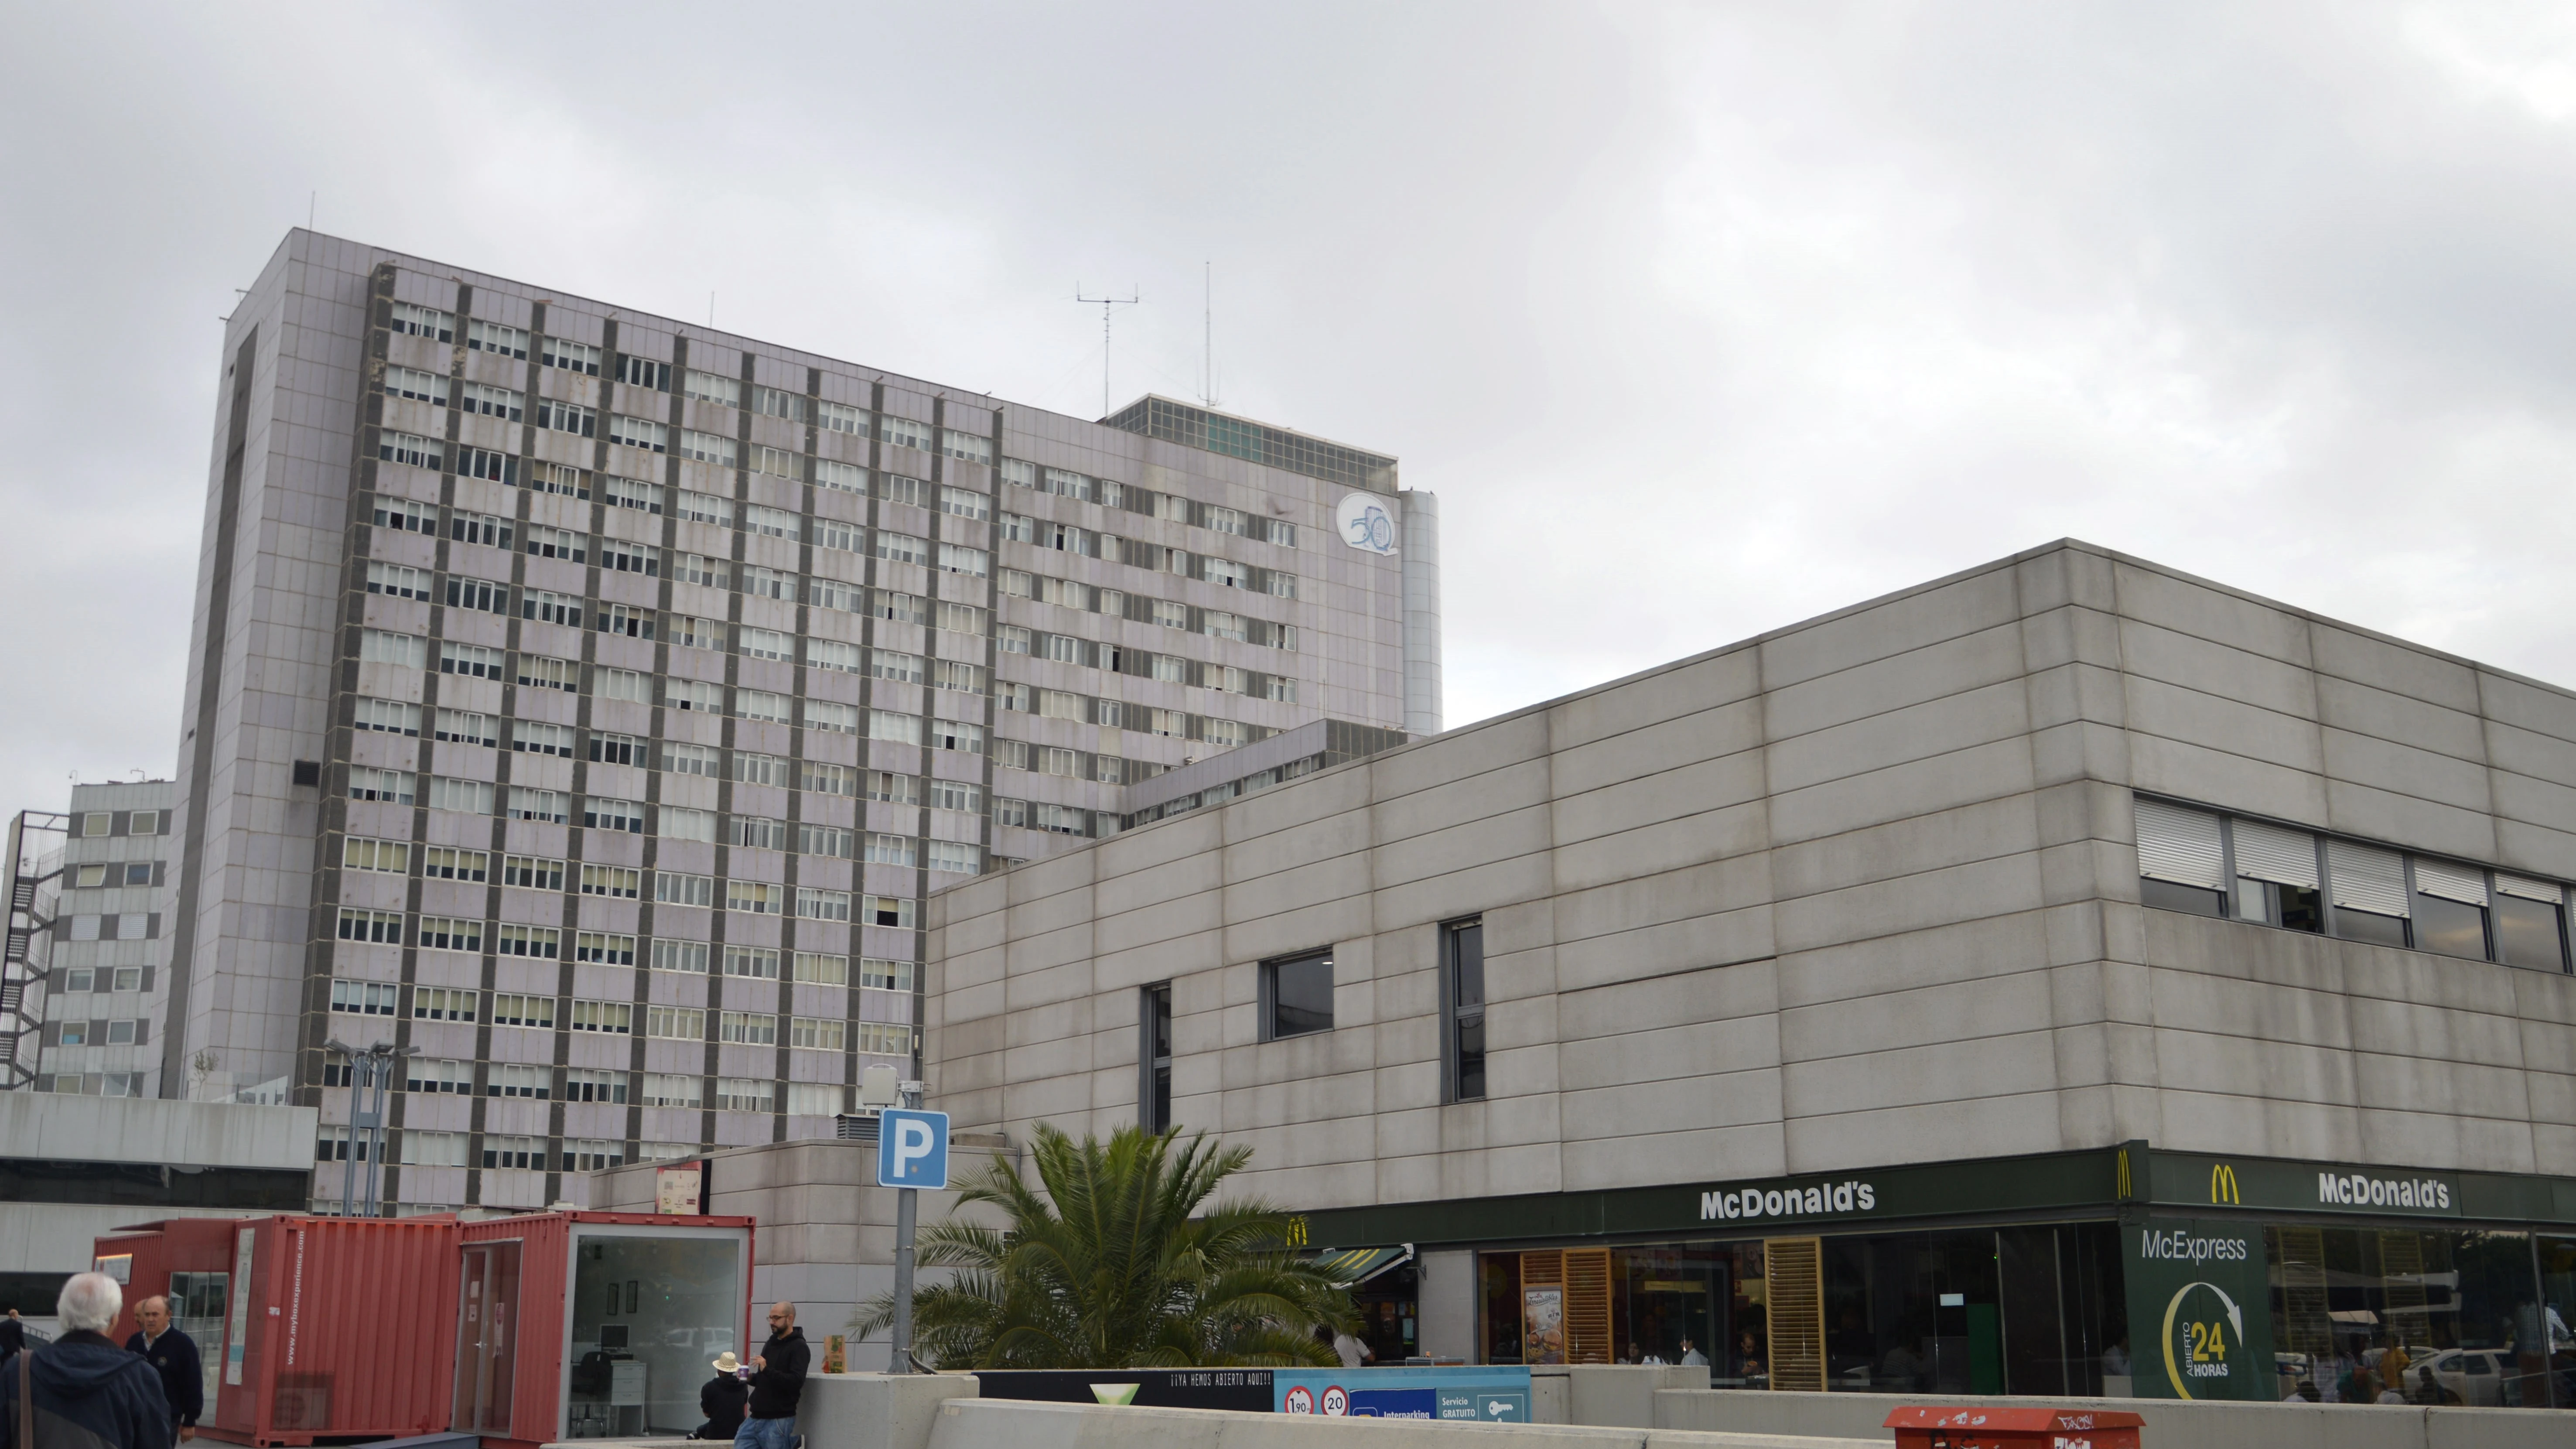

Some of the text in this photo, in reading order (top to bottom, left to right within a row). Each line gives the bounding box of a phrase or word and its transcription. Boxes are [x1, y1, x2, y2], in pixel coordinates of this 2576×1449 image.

[893, 1118, 934, 1178] P
[1701, 1181, 1875, 1220] McDonald's
[2319, 1173, 2450, 1209] McDonald's
[2142, 1230, 2246, 1266] McExpress
[288, 1231, 304, 1364] www.myboxexperience.com
[2183, 1322, 2194, 1377] ABIERTO
[2191, 1322, 2225, 1361] 24
[1191, 1374, 1211, 1386] HEMOS
[1216, 1373, 1243, 1386] ABIERTO
[2194, 1364, 2228, 1377] HORAS
[1328, 1397, 1343, 1410] 20
[1442, 1397, 1468, 1406] Servicio
[1443, 1408, 1475, 1418] GRATUITO
